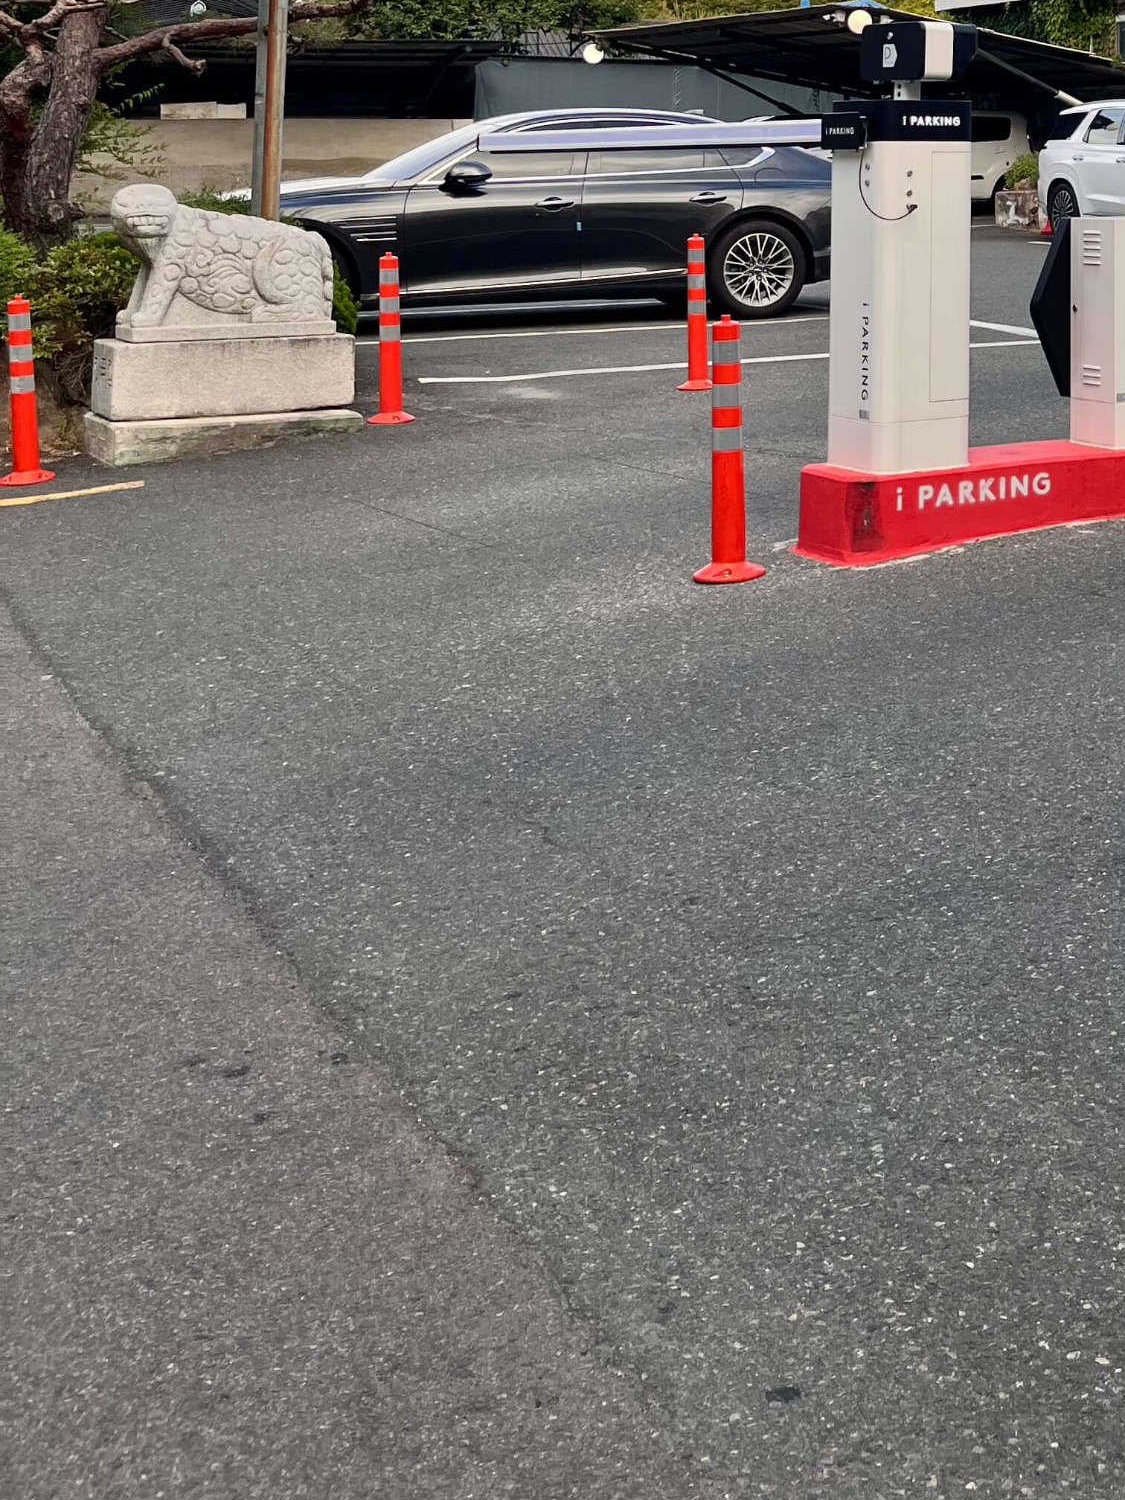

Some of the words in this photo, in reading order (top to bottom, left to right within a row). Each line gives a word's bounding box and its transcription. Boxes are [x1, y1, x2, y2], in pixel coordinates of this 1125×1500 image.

[829, 126, 855, 136] PARKING
[910, 116, 961, 127] PARKING
[861, 316, 870, 401] PARKING
[896, 487, 903, 512] i
[918, 472, 1051, 510] PARKING
